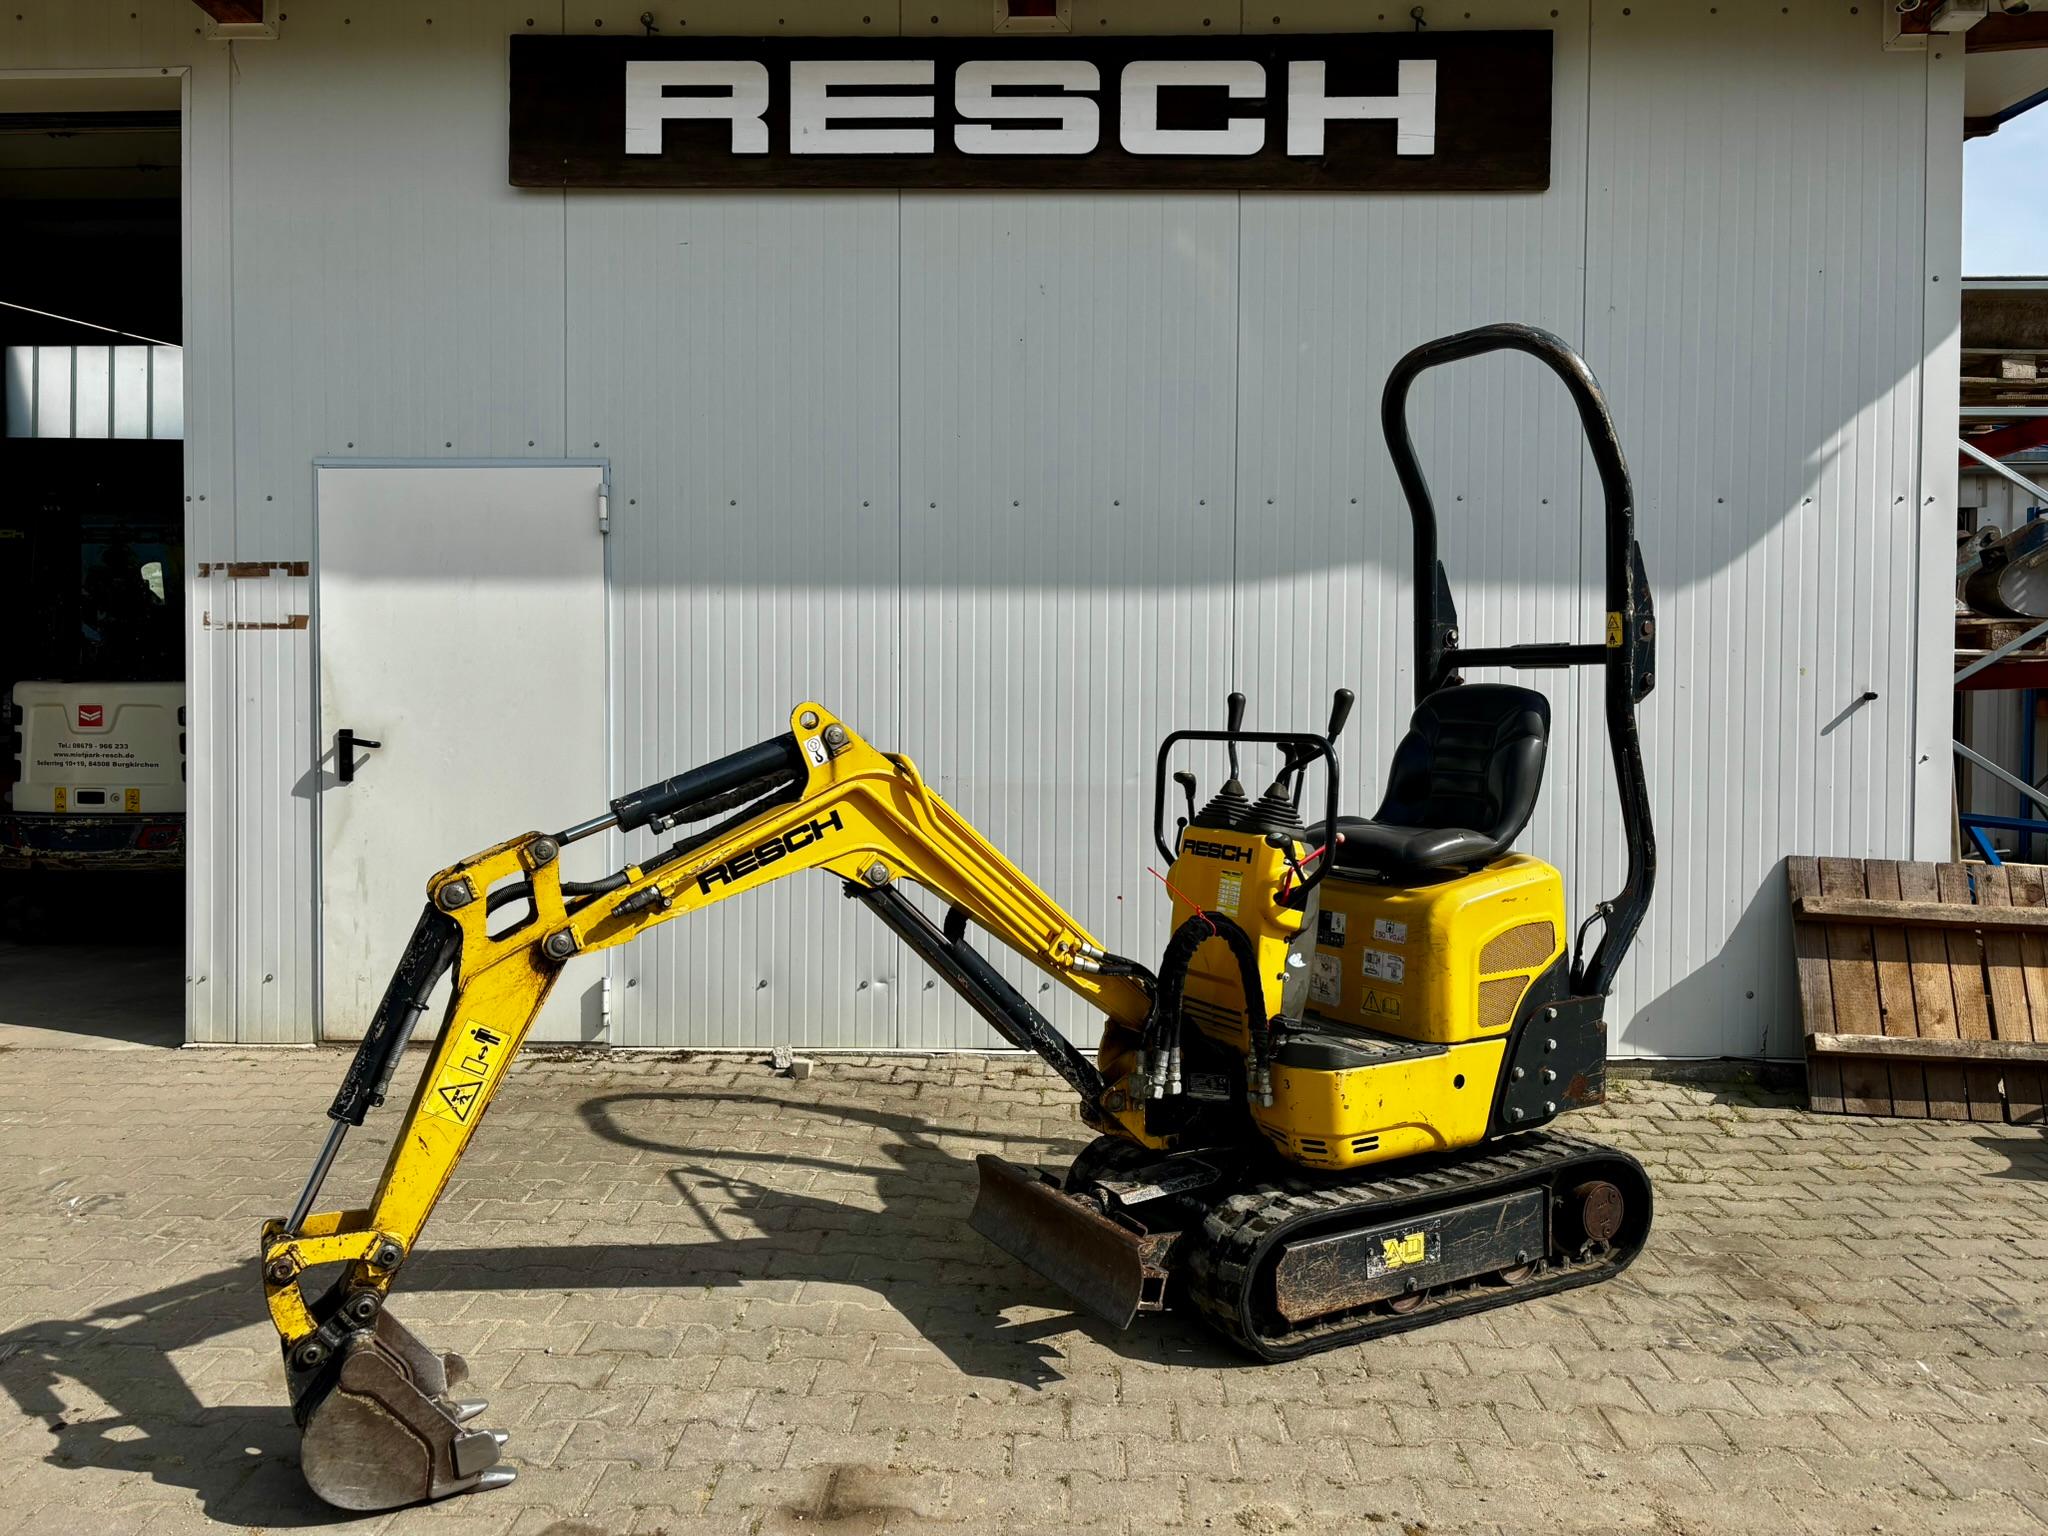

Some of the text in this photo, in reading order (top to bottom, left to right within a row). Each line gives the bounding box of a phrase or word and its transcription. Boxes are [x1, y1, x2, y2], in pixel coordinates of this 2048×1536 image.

[624, 59, 1438, 157] RESCH
[112, 761, 159, 769] Burgkirchen
[695, 810, 844, 895] RESCH
[1182, 839, 1253, 865] RESCH
